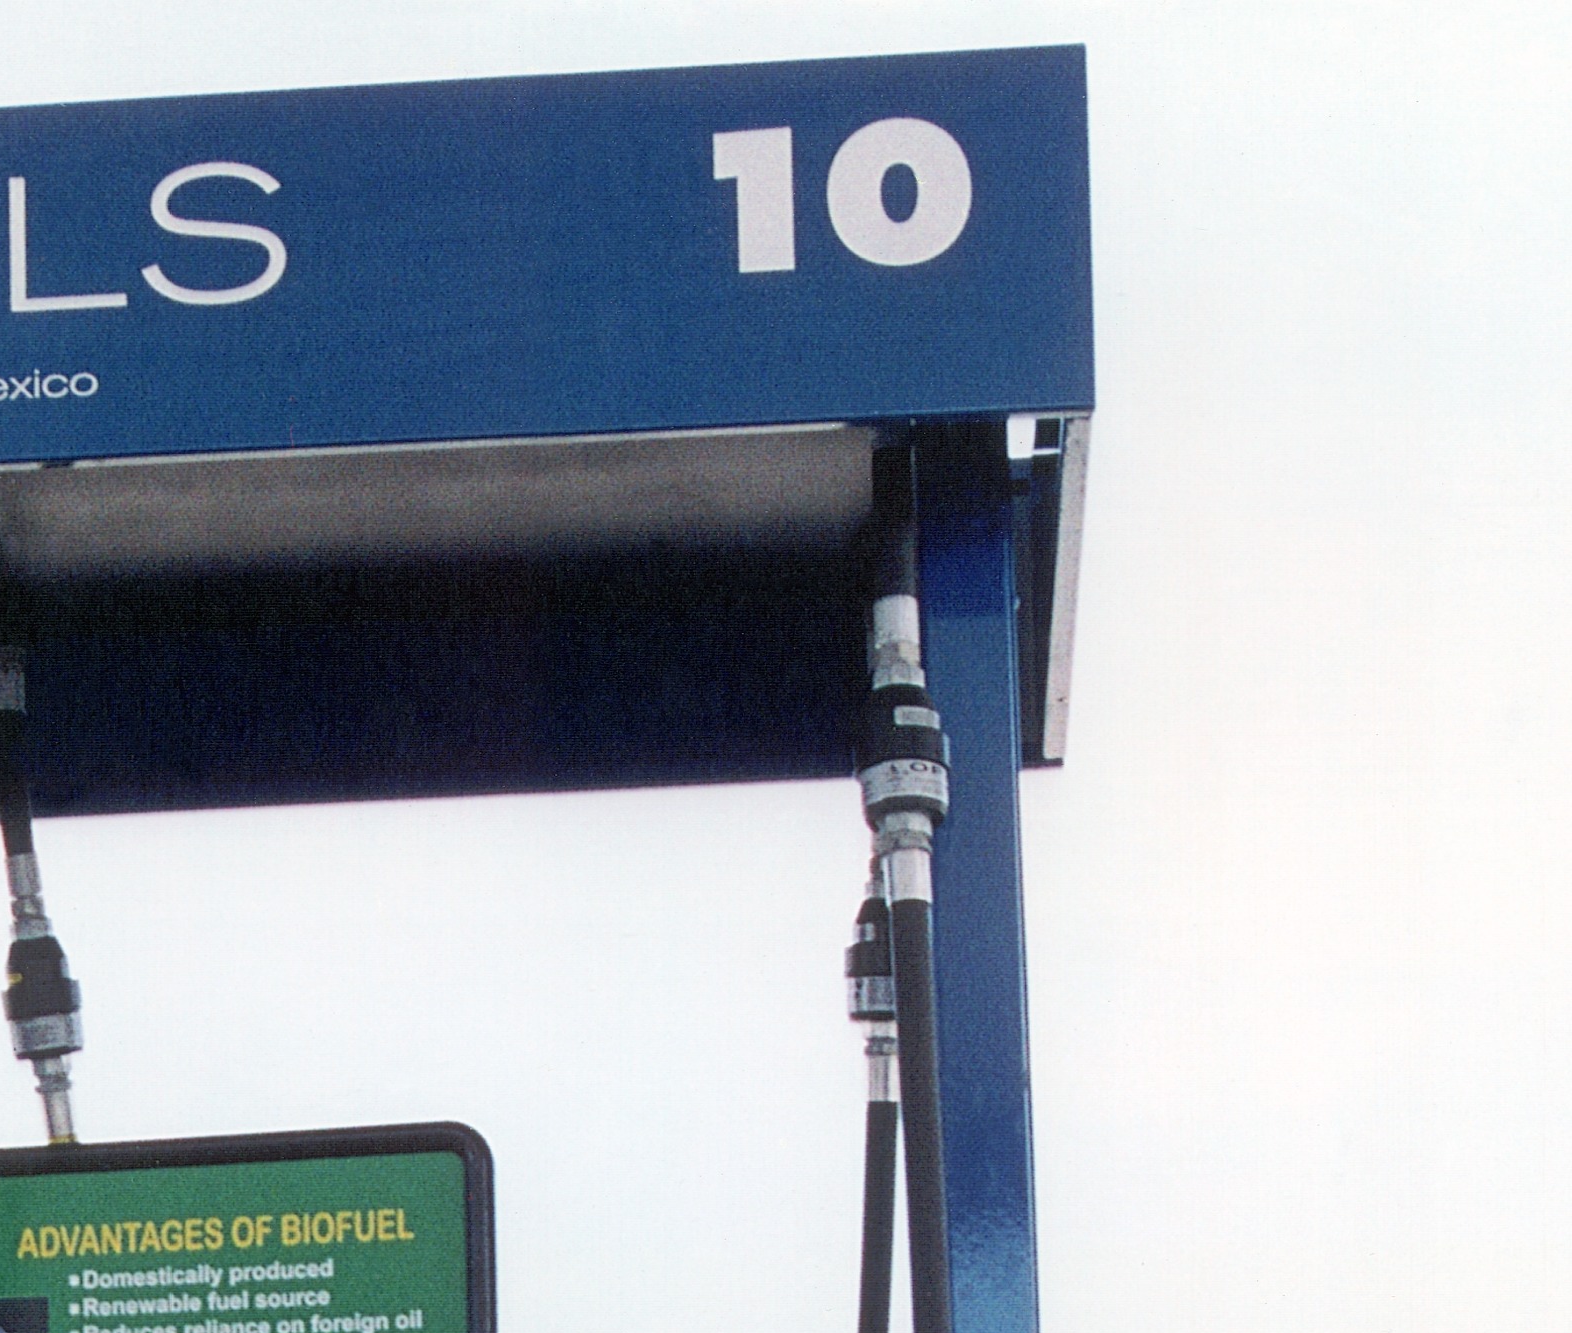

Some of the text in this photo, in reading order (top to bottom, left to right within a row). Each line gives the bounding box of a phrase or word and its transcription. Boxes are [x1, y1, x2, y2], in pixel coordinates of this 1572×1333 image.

[713, 117, 973, 273] 10
[17, 1208, 415, 1259] ADVANTAGES OF BIOFUEL
[82, 1258, 334, 1289] Domestically produced
[82, 1290, 331, 1316] Renewable fuel source
[394, 1309, 423, 1330] oil
